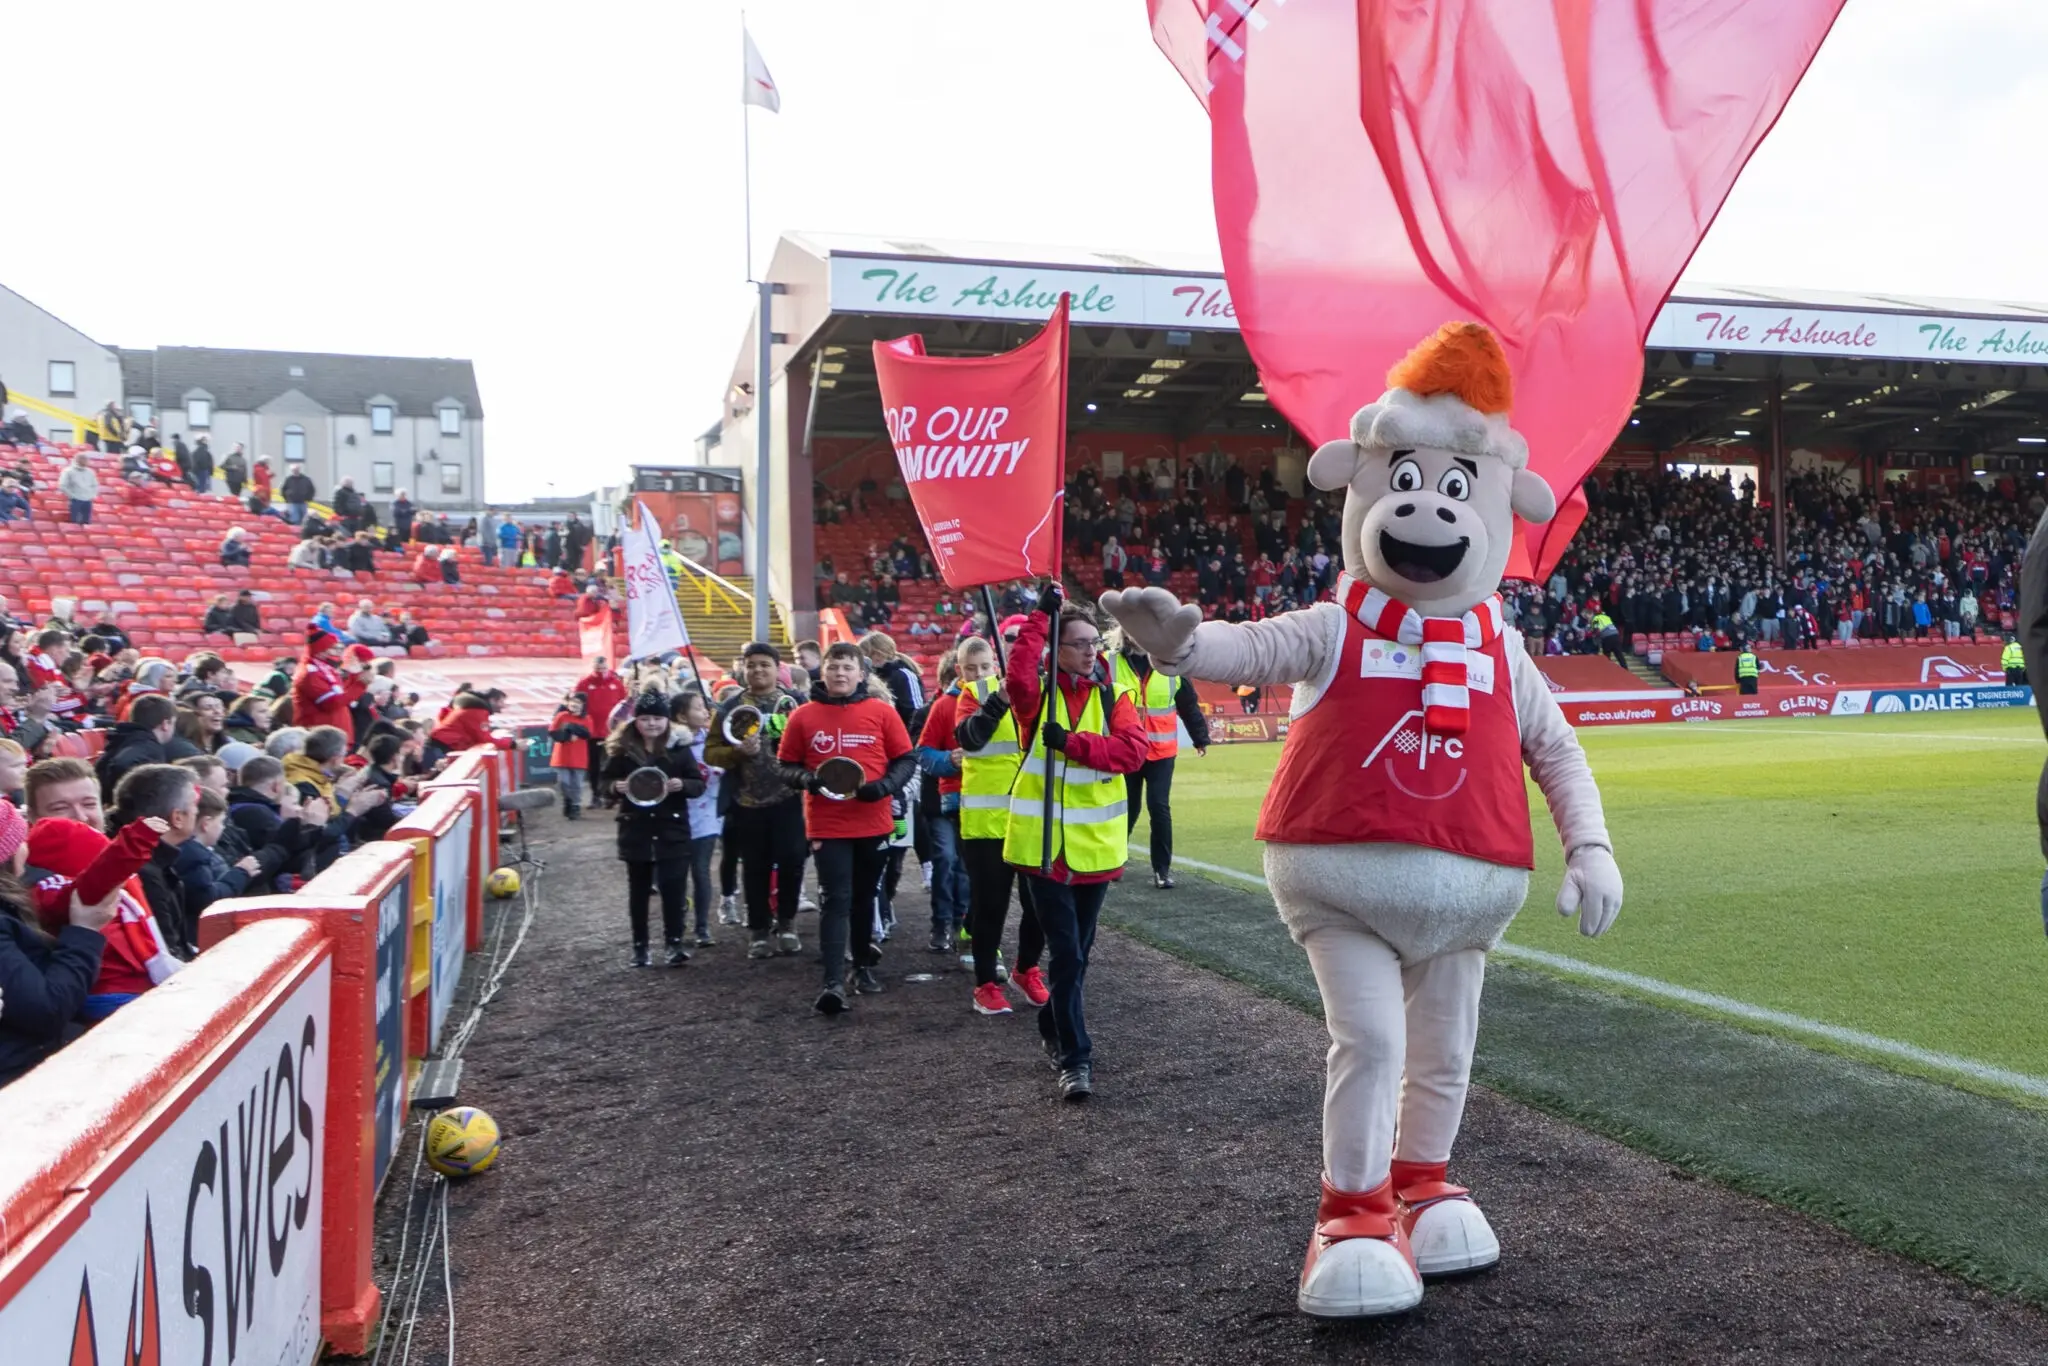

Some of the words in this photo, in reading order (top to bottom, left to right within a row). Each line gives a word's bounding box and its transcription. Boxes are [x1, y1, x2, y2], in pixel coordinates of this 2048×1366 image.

[862, 268, 939, 303] The
[1173, 286, 1236, 318] The
[1696, 312, 1750, 342] The
[1761, 316, 1878, 348] Ashvale
[1919, 323, 1969, 351] The
[885, 406, 917, 443] OR
[927, 406, 1009, 442] OUR
[1671, 700, 1722, 717] GLEN'S
[1779, 696, 1829, 712] GLEN'S
[1909, 692, 1975, 711] DALES
[1977, 690, 2025, 700] ENGINEERING
